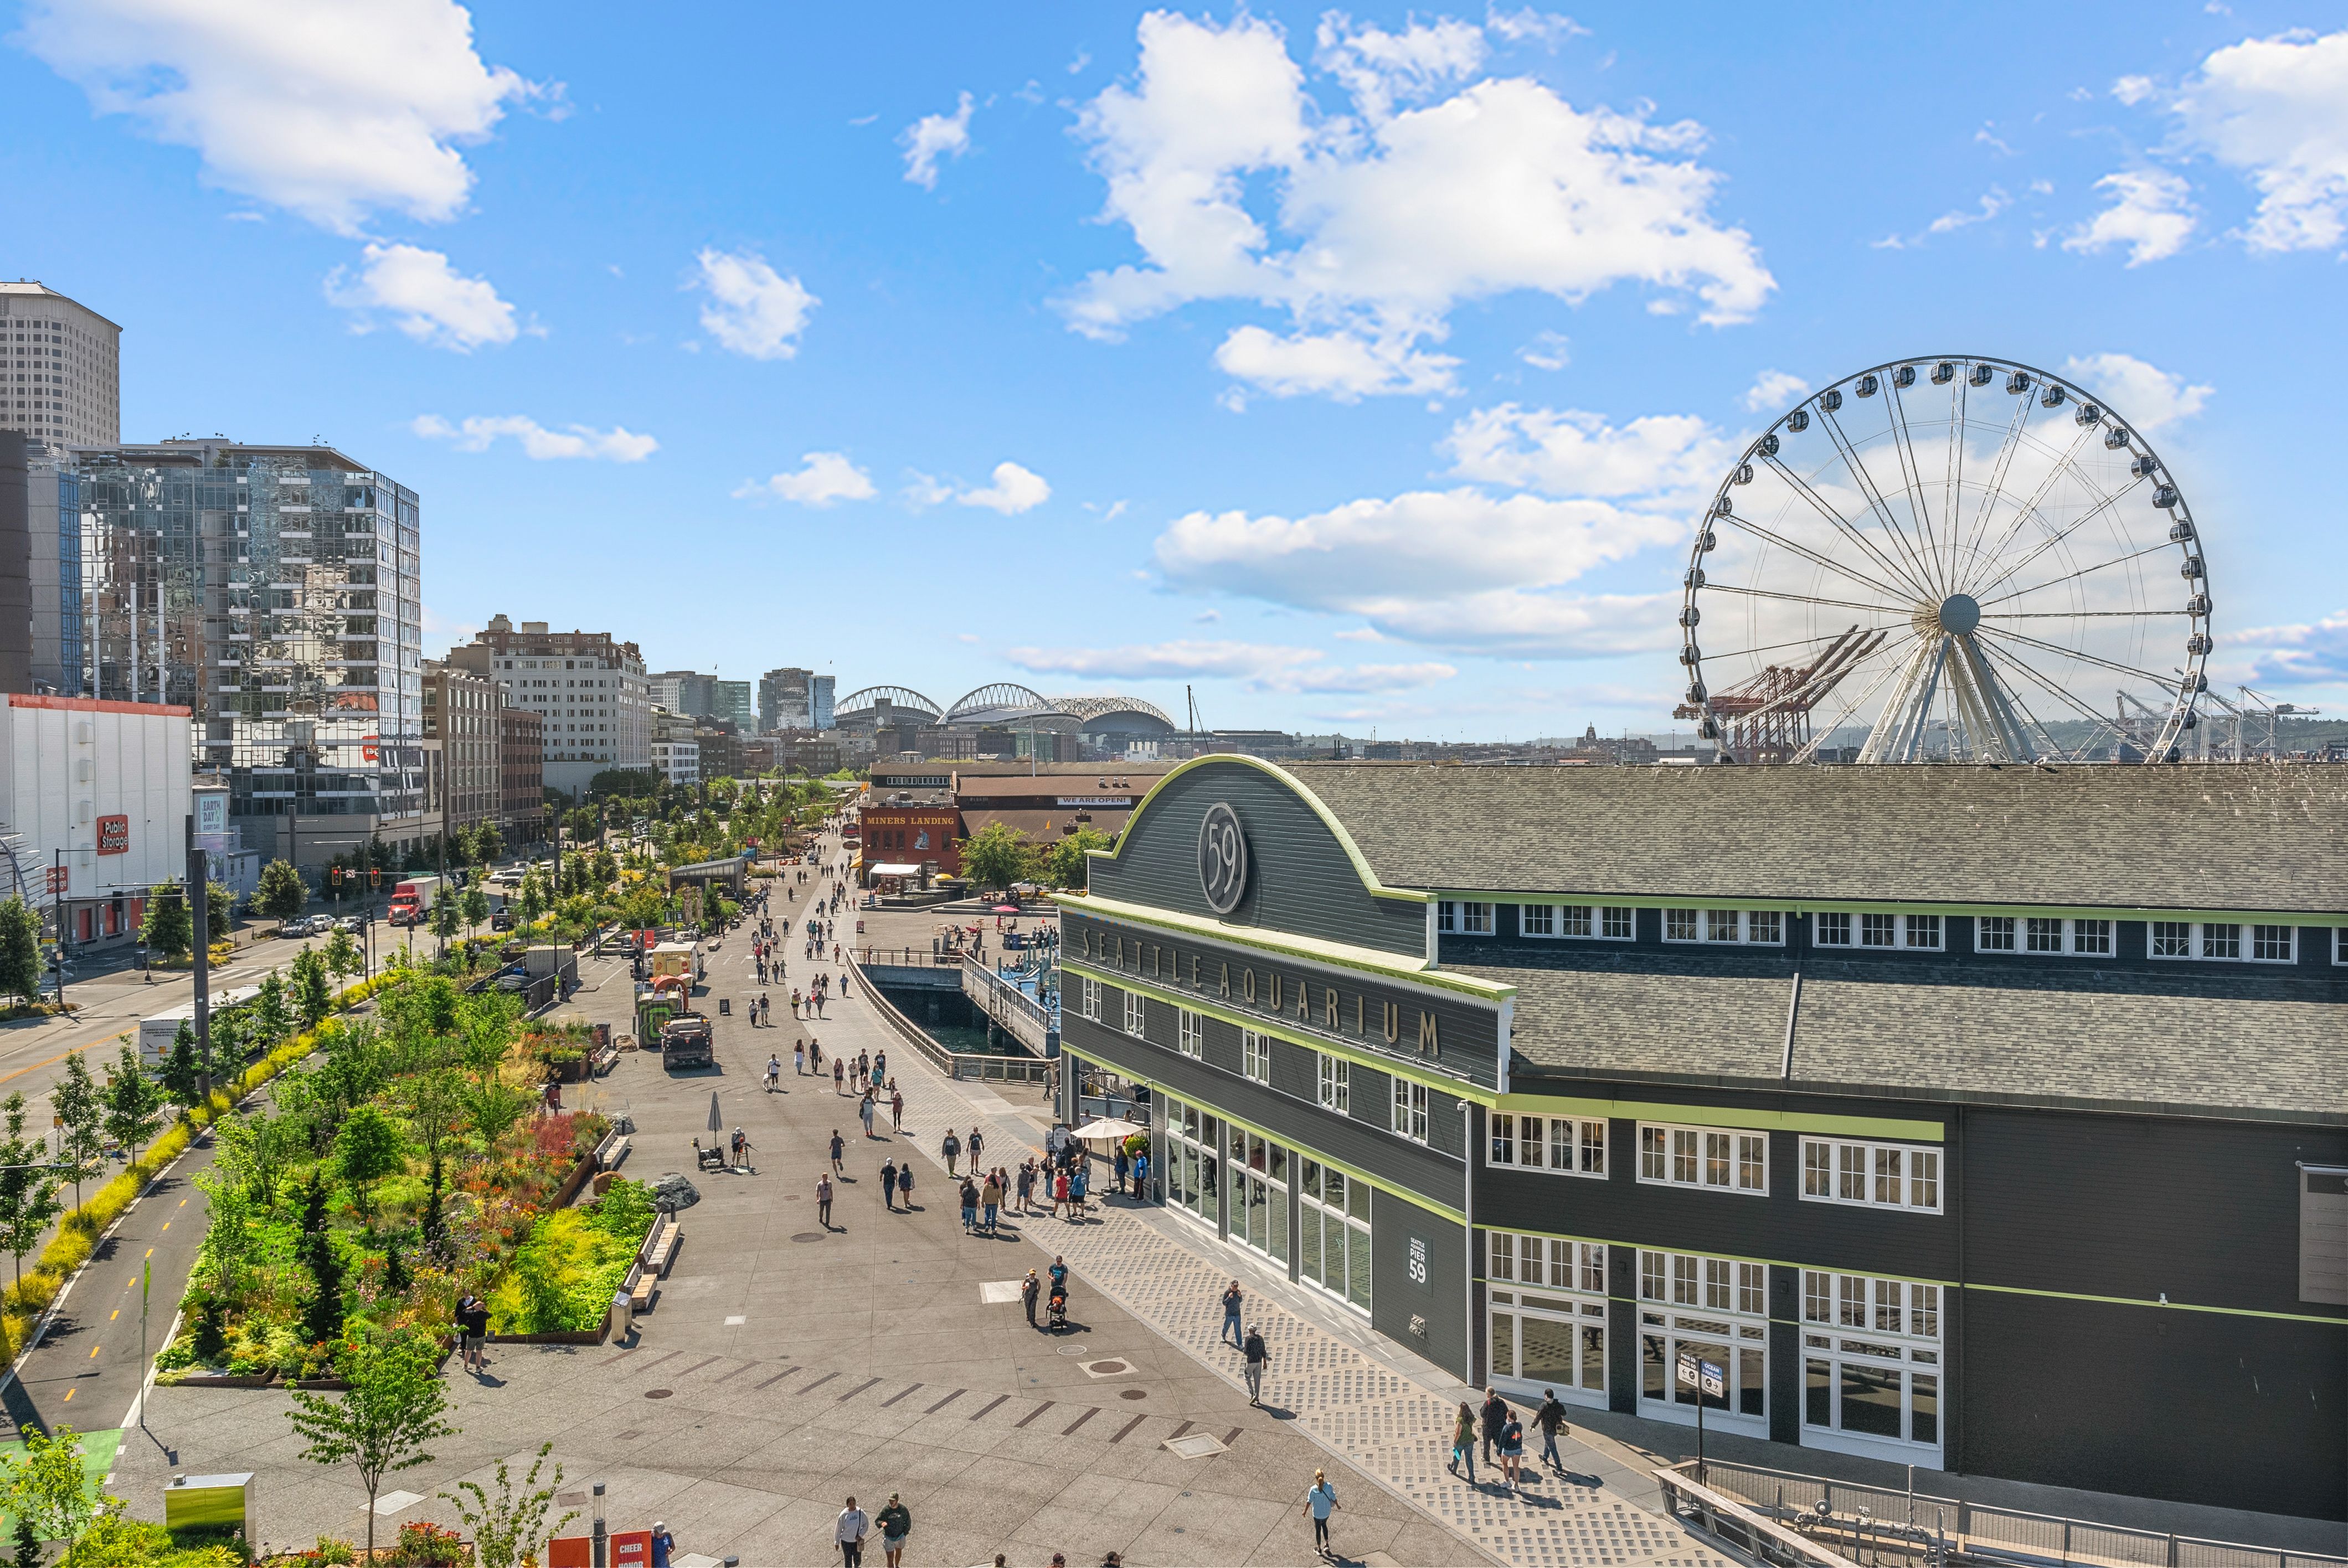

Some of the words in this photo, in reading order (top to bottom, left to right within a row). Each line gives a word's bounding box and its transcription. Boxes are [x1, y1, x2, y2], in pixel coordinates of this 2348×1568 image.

[203, 800, 221, 811] EARTH
[203, 812, 214, 822] DAY
[105, 821, 126, 834] Public
[102, 835, 128, 849] Storage
[1209, 823, 1238, 895] 59
[1083, 928, 1202, 988] SEATTLE
[1220, 962, 1438, 1055] AQUARIUM
[1410, 1237, 1425, 1248] SEATTLE
[1410, 1247, 1425, 1263] PIER
[1409, 1258, 1426, 1283] 59
[1681, 1359, 1690, 1367] PIER
[1705, 1363, 1719, 1373] OCEAN
[1702, 1368, 1722, 1381] PAVILION
[619, 1543, 642, 1554] CHEER
